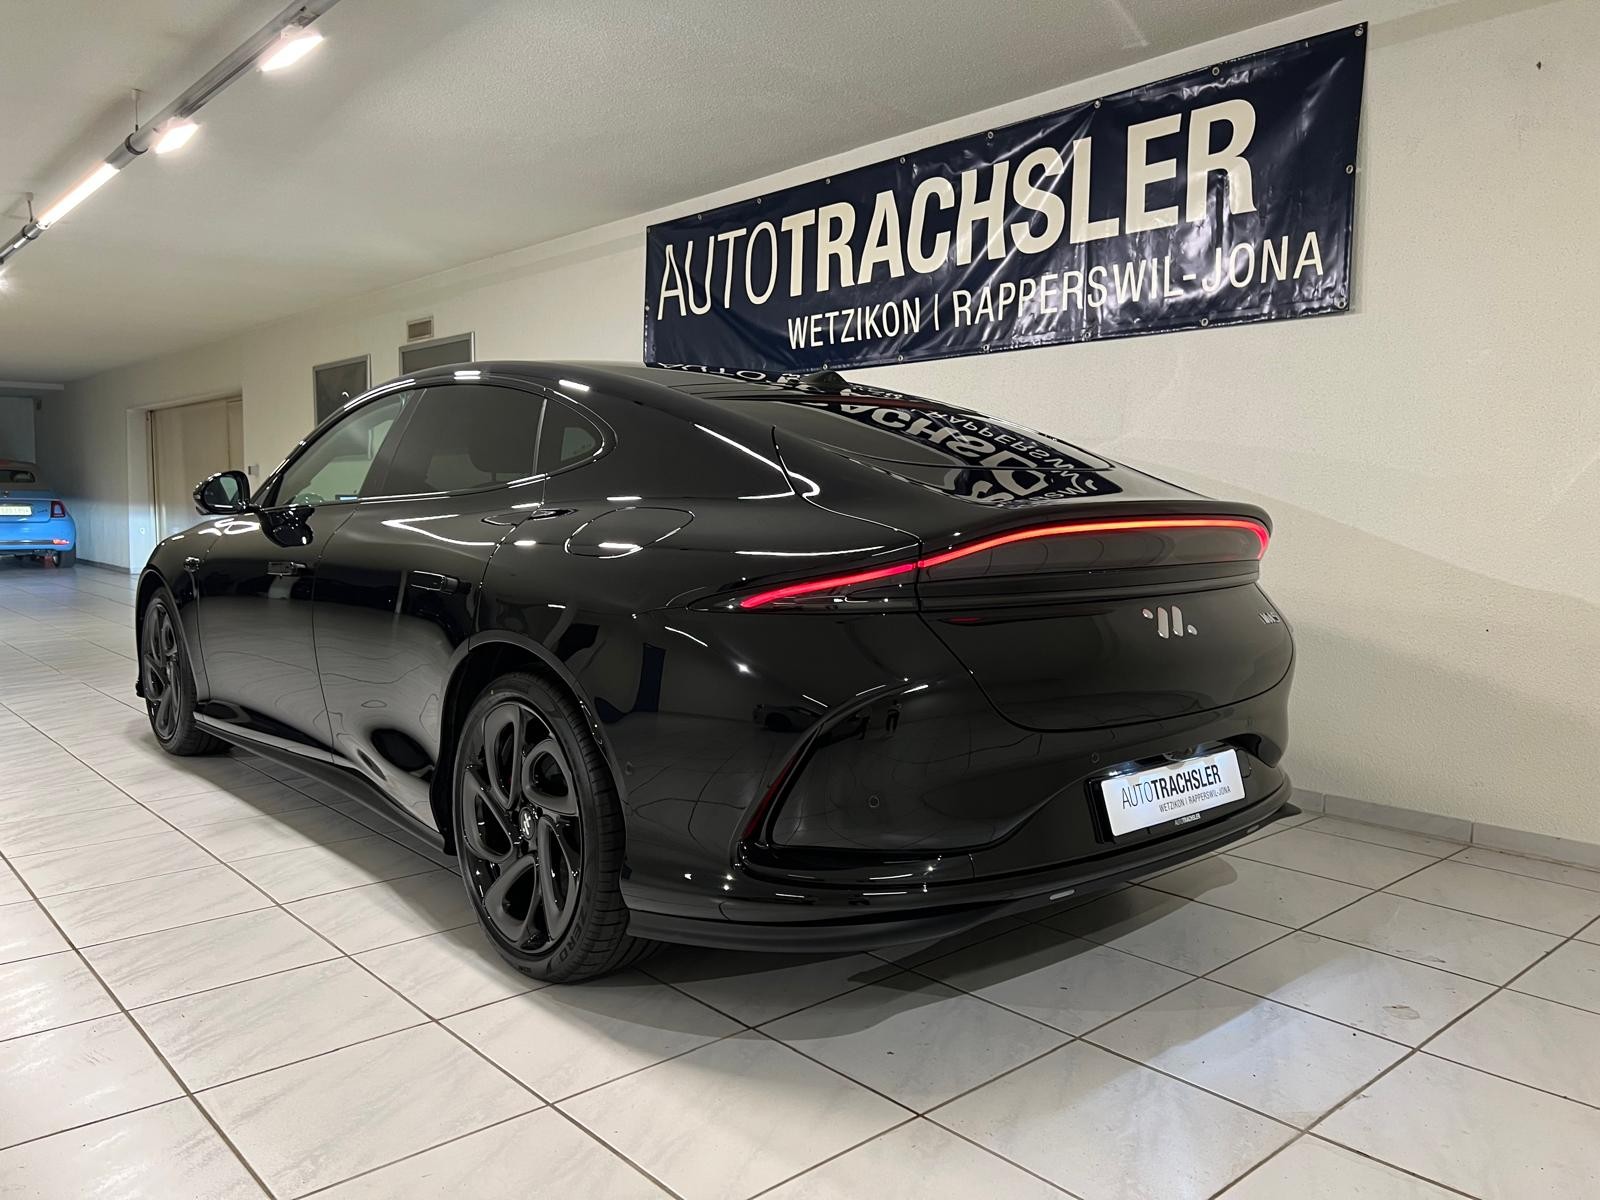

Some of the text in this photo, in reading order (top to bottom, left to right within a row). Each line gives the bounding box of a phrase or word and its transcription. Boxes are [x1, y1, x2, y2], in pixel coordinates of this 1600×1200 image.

[657, 99, 1258, 321] AUTOTRACHSLER
[788, 300, 920, 350] WETZIKON
[952, 231, 1324, 329] RAPPERSWIL-JONA
[1121, 764, 1222, 810] AUTOTRACHSLER
[1159, 799, 1185, 813] WETZIKON
[1188, 785, 1232, 805] RAPPERSWIL-JONA
